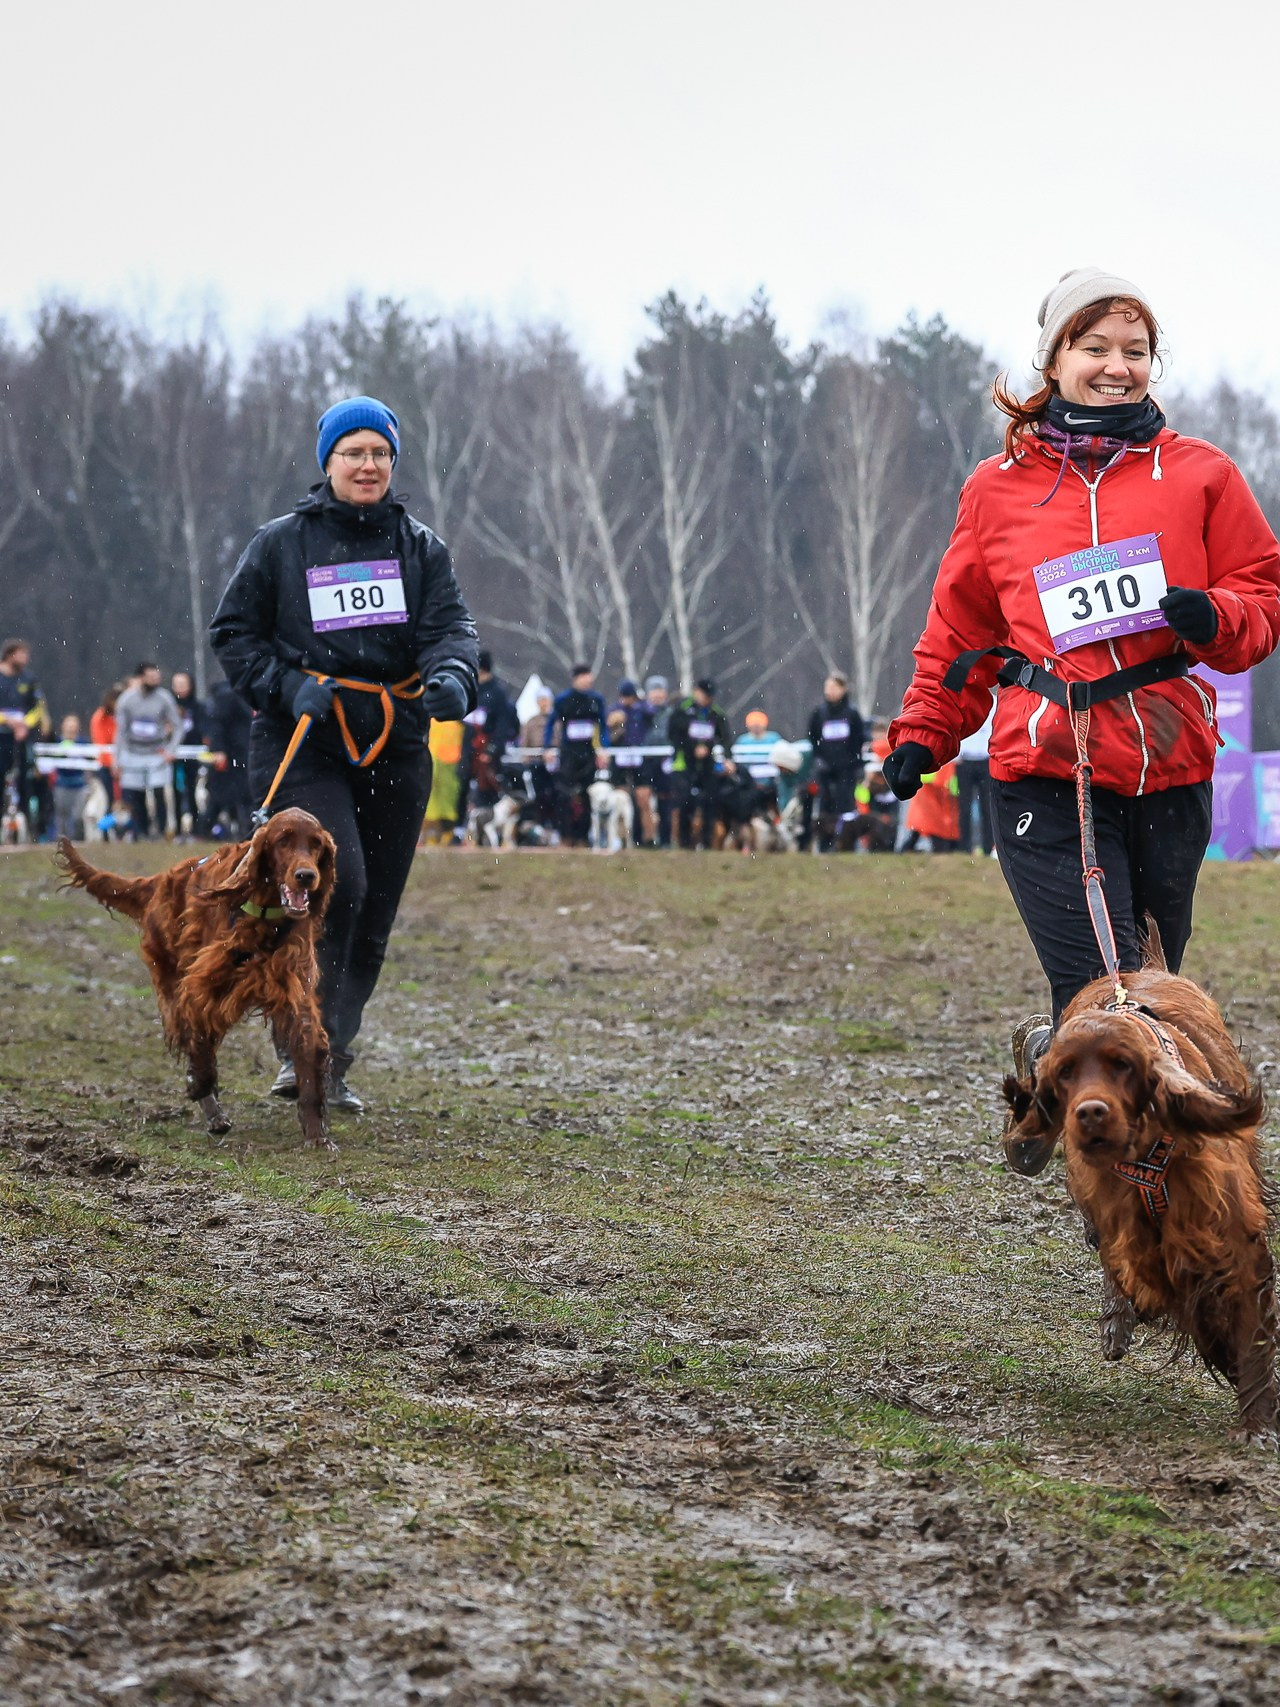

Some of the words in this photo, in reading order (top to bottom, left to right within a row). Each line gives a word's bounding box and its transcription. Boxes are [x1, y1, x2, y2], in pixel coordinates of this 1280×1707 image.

[1072, 551, 1119, 573] БЫСТРЫЙ
[1127, 549, 1134, 558] 2
[1039, 562, 1065, 576] 11/04
[1041, 569, 1067, 584] 2026
[333, 585, 384, 612] 180
[1068, 574, 1141, 620] 310
